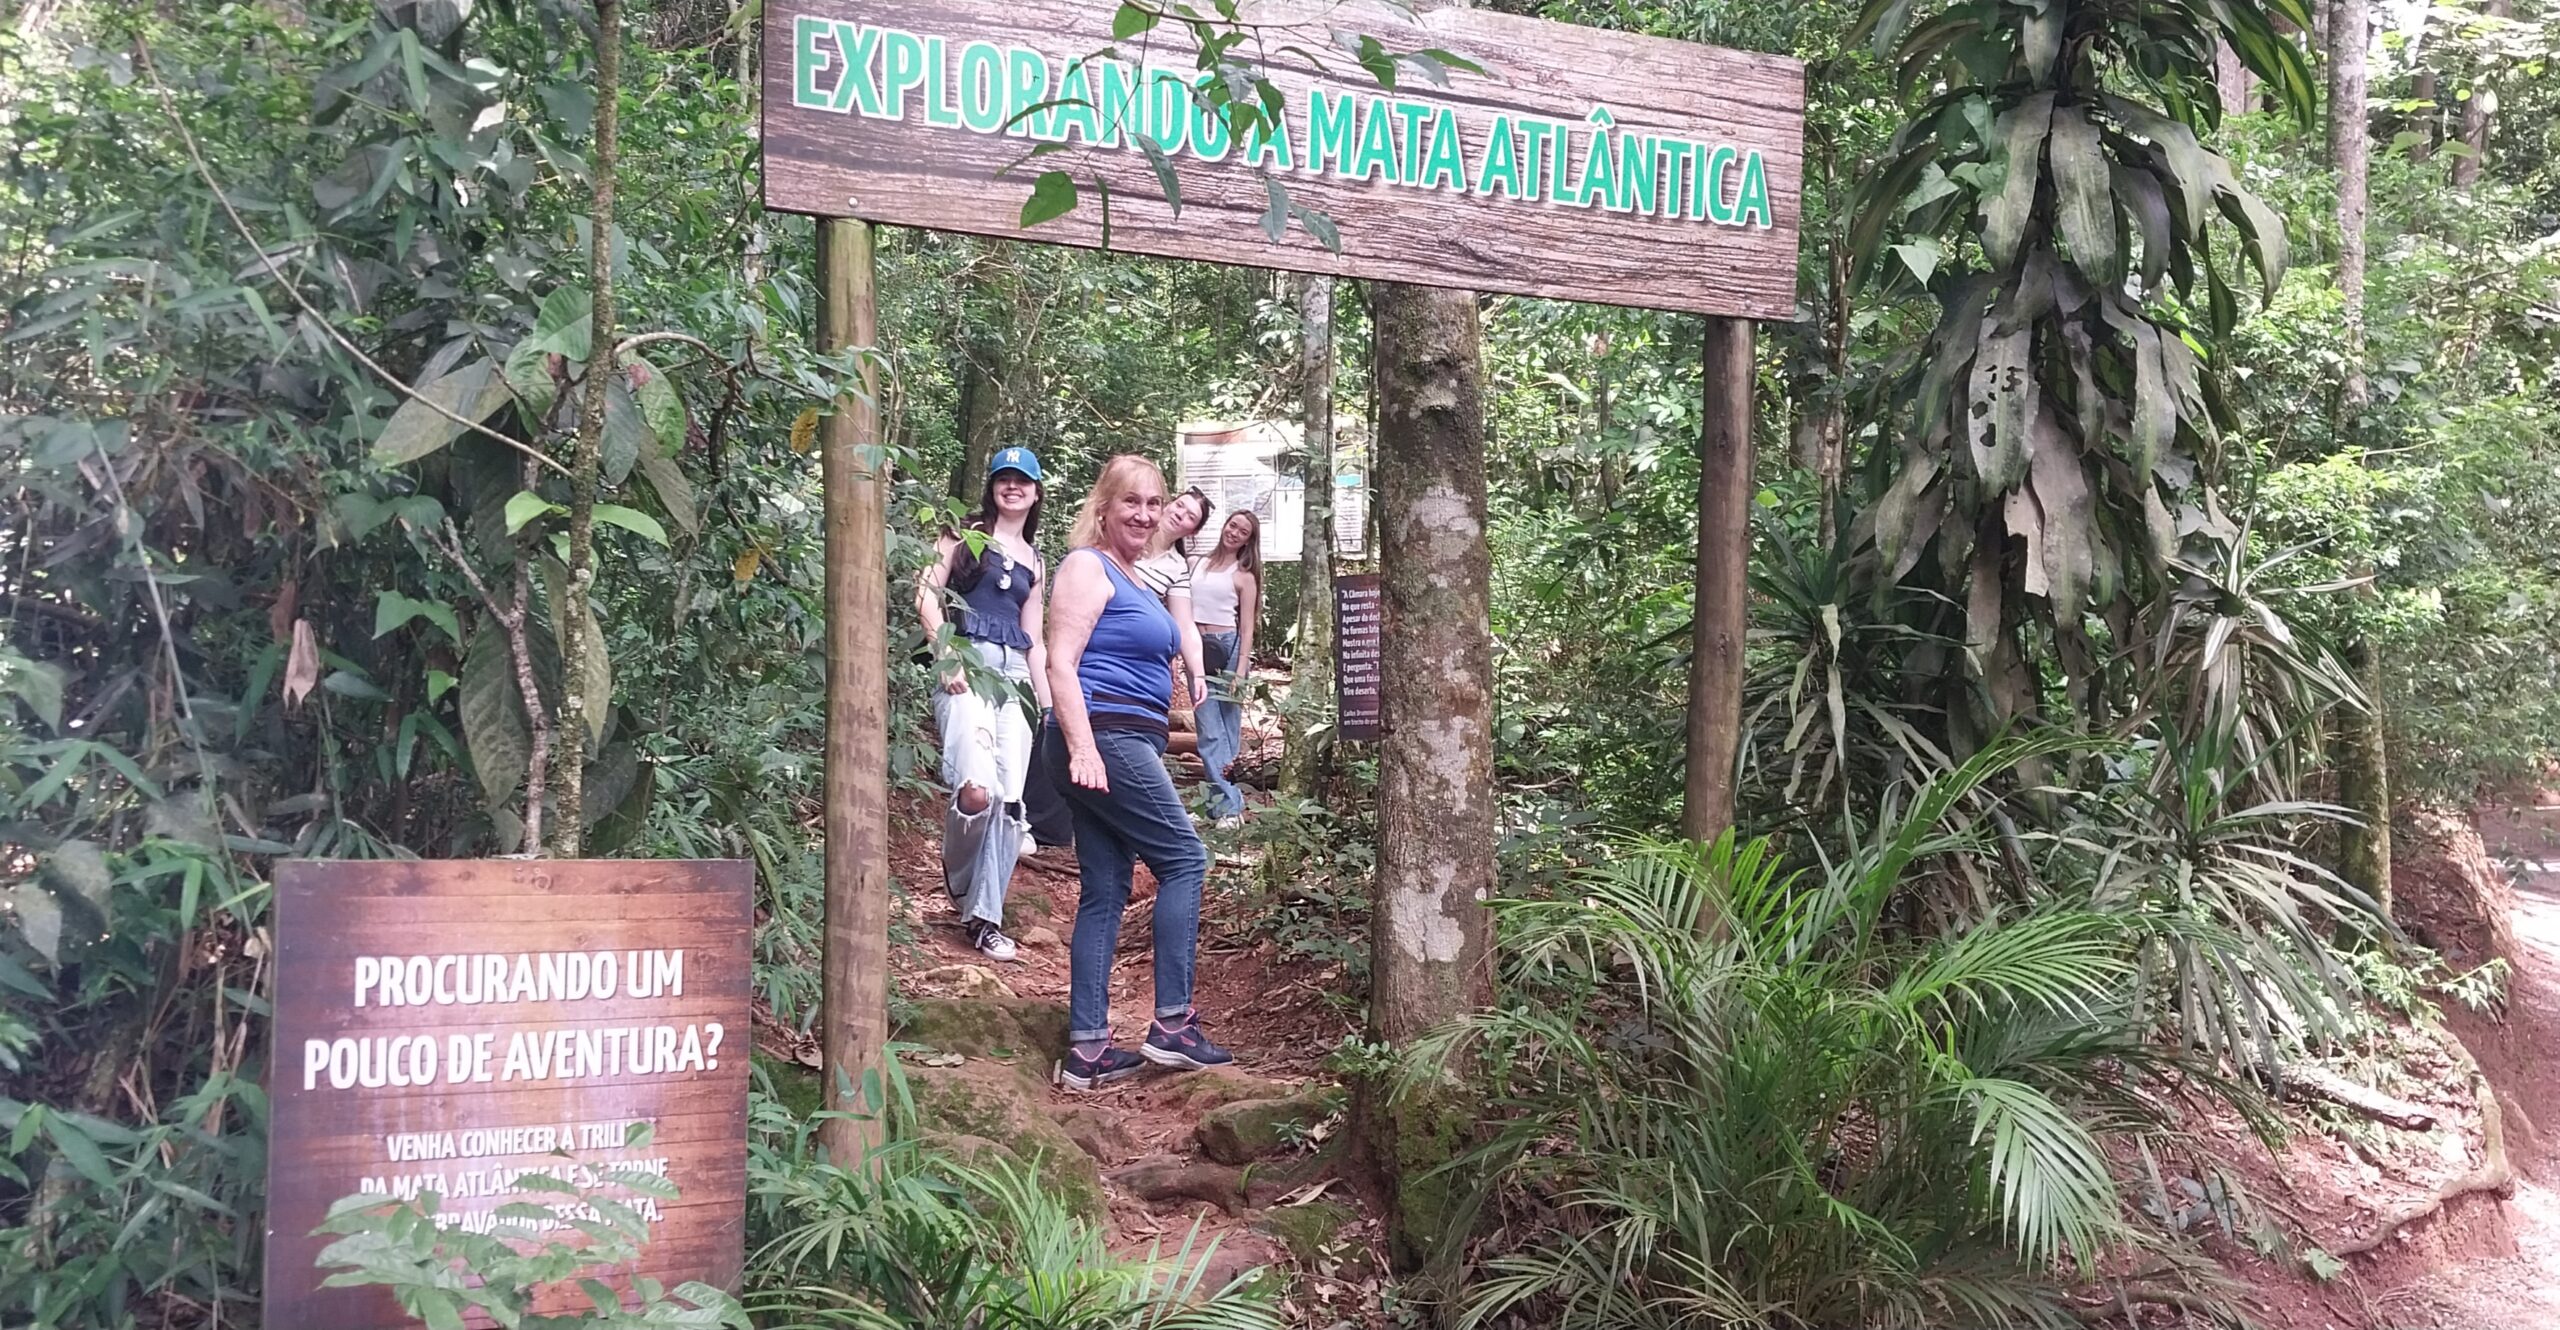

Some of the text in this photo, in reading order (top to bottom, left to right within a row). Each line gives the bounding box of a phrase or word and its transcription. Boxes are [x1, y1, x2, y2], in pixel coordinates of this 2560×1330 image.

[793, 15, 1232, 162] EXPLORANDO
[1306, 85, 1467, 193] MATA
[1475, 104, 1772, 230] ATLÂNTICA
[1350, 603, 1360, 612] que
[1361, 601, 1375, 609] resta
[1342, 639, 1360, 647] Mostra
[1350, 626, 1368, 635] formas
[1343, 675, 1353, 685] Que
[355, 950, 684, 1007] PROCURANDO UM
[303, 1023, 724, 1091] POUCO DE AVENTURA?
[387, 1132, 456, 1162] VENHA
[461, 1126, 556, 1157] CONHECER
[560, 1123, 575, 1150] A
